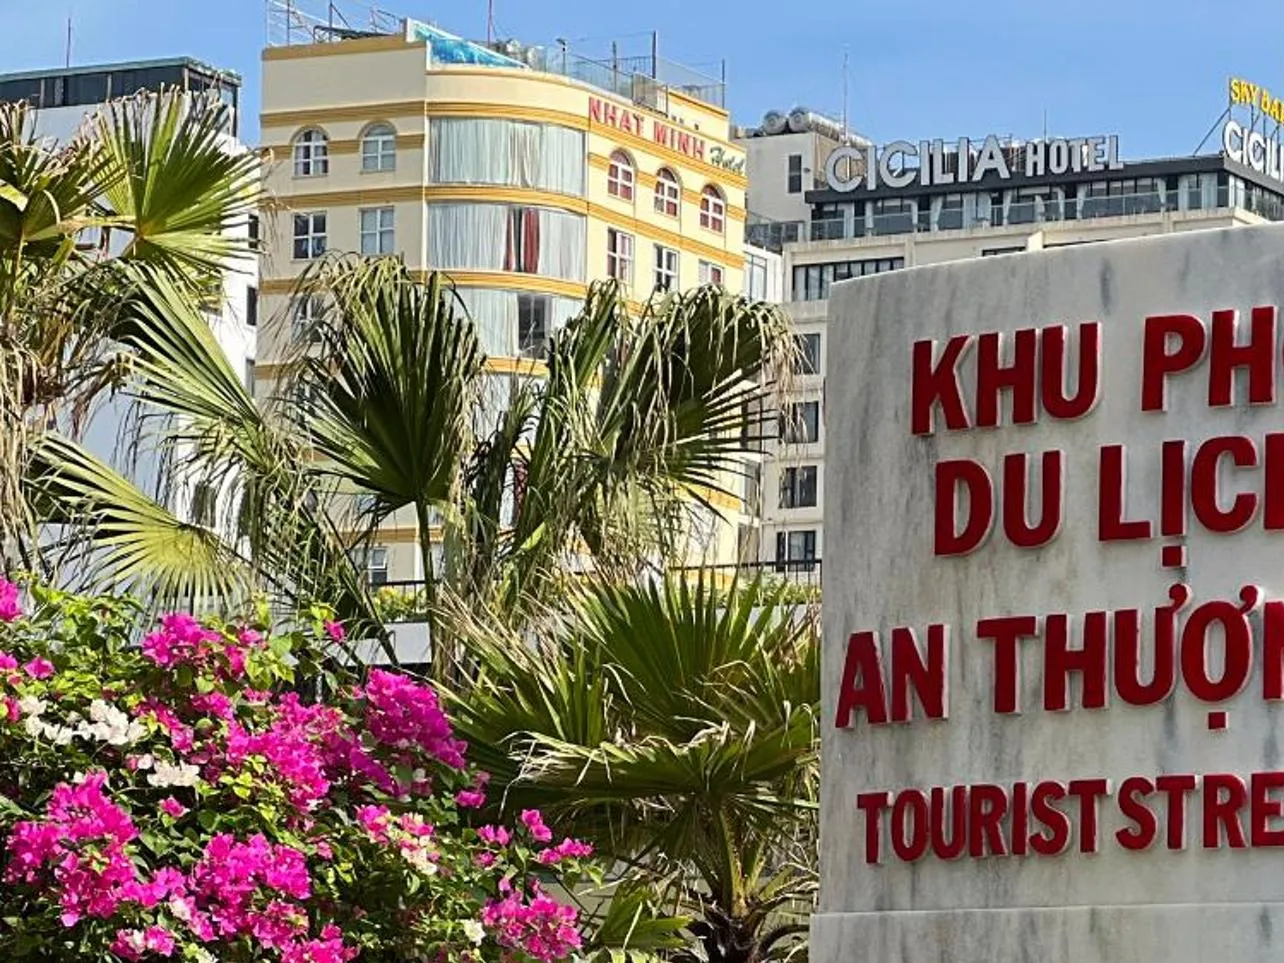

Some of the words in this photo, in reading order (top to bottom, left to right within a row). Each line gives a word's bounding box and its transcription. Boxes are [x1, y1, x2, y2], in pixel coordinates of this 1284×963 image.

[588, 96, 645, 136] NHAT
[653, 120, 705, 160] MINH
[1231, 79, 1258, 107] SKY
[825, 134, 1011, 192] CICILIA
[1025, 135, 1124, 178] HOTEL
[911, 321, 1102, 436] KHU
[934, 449, 1065, 557] DU
[835, 624, 949, 729] AN
[857, 777, 1111, 865] TOURIST
